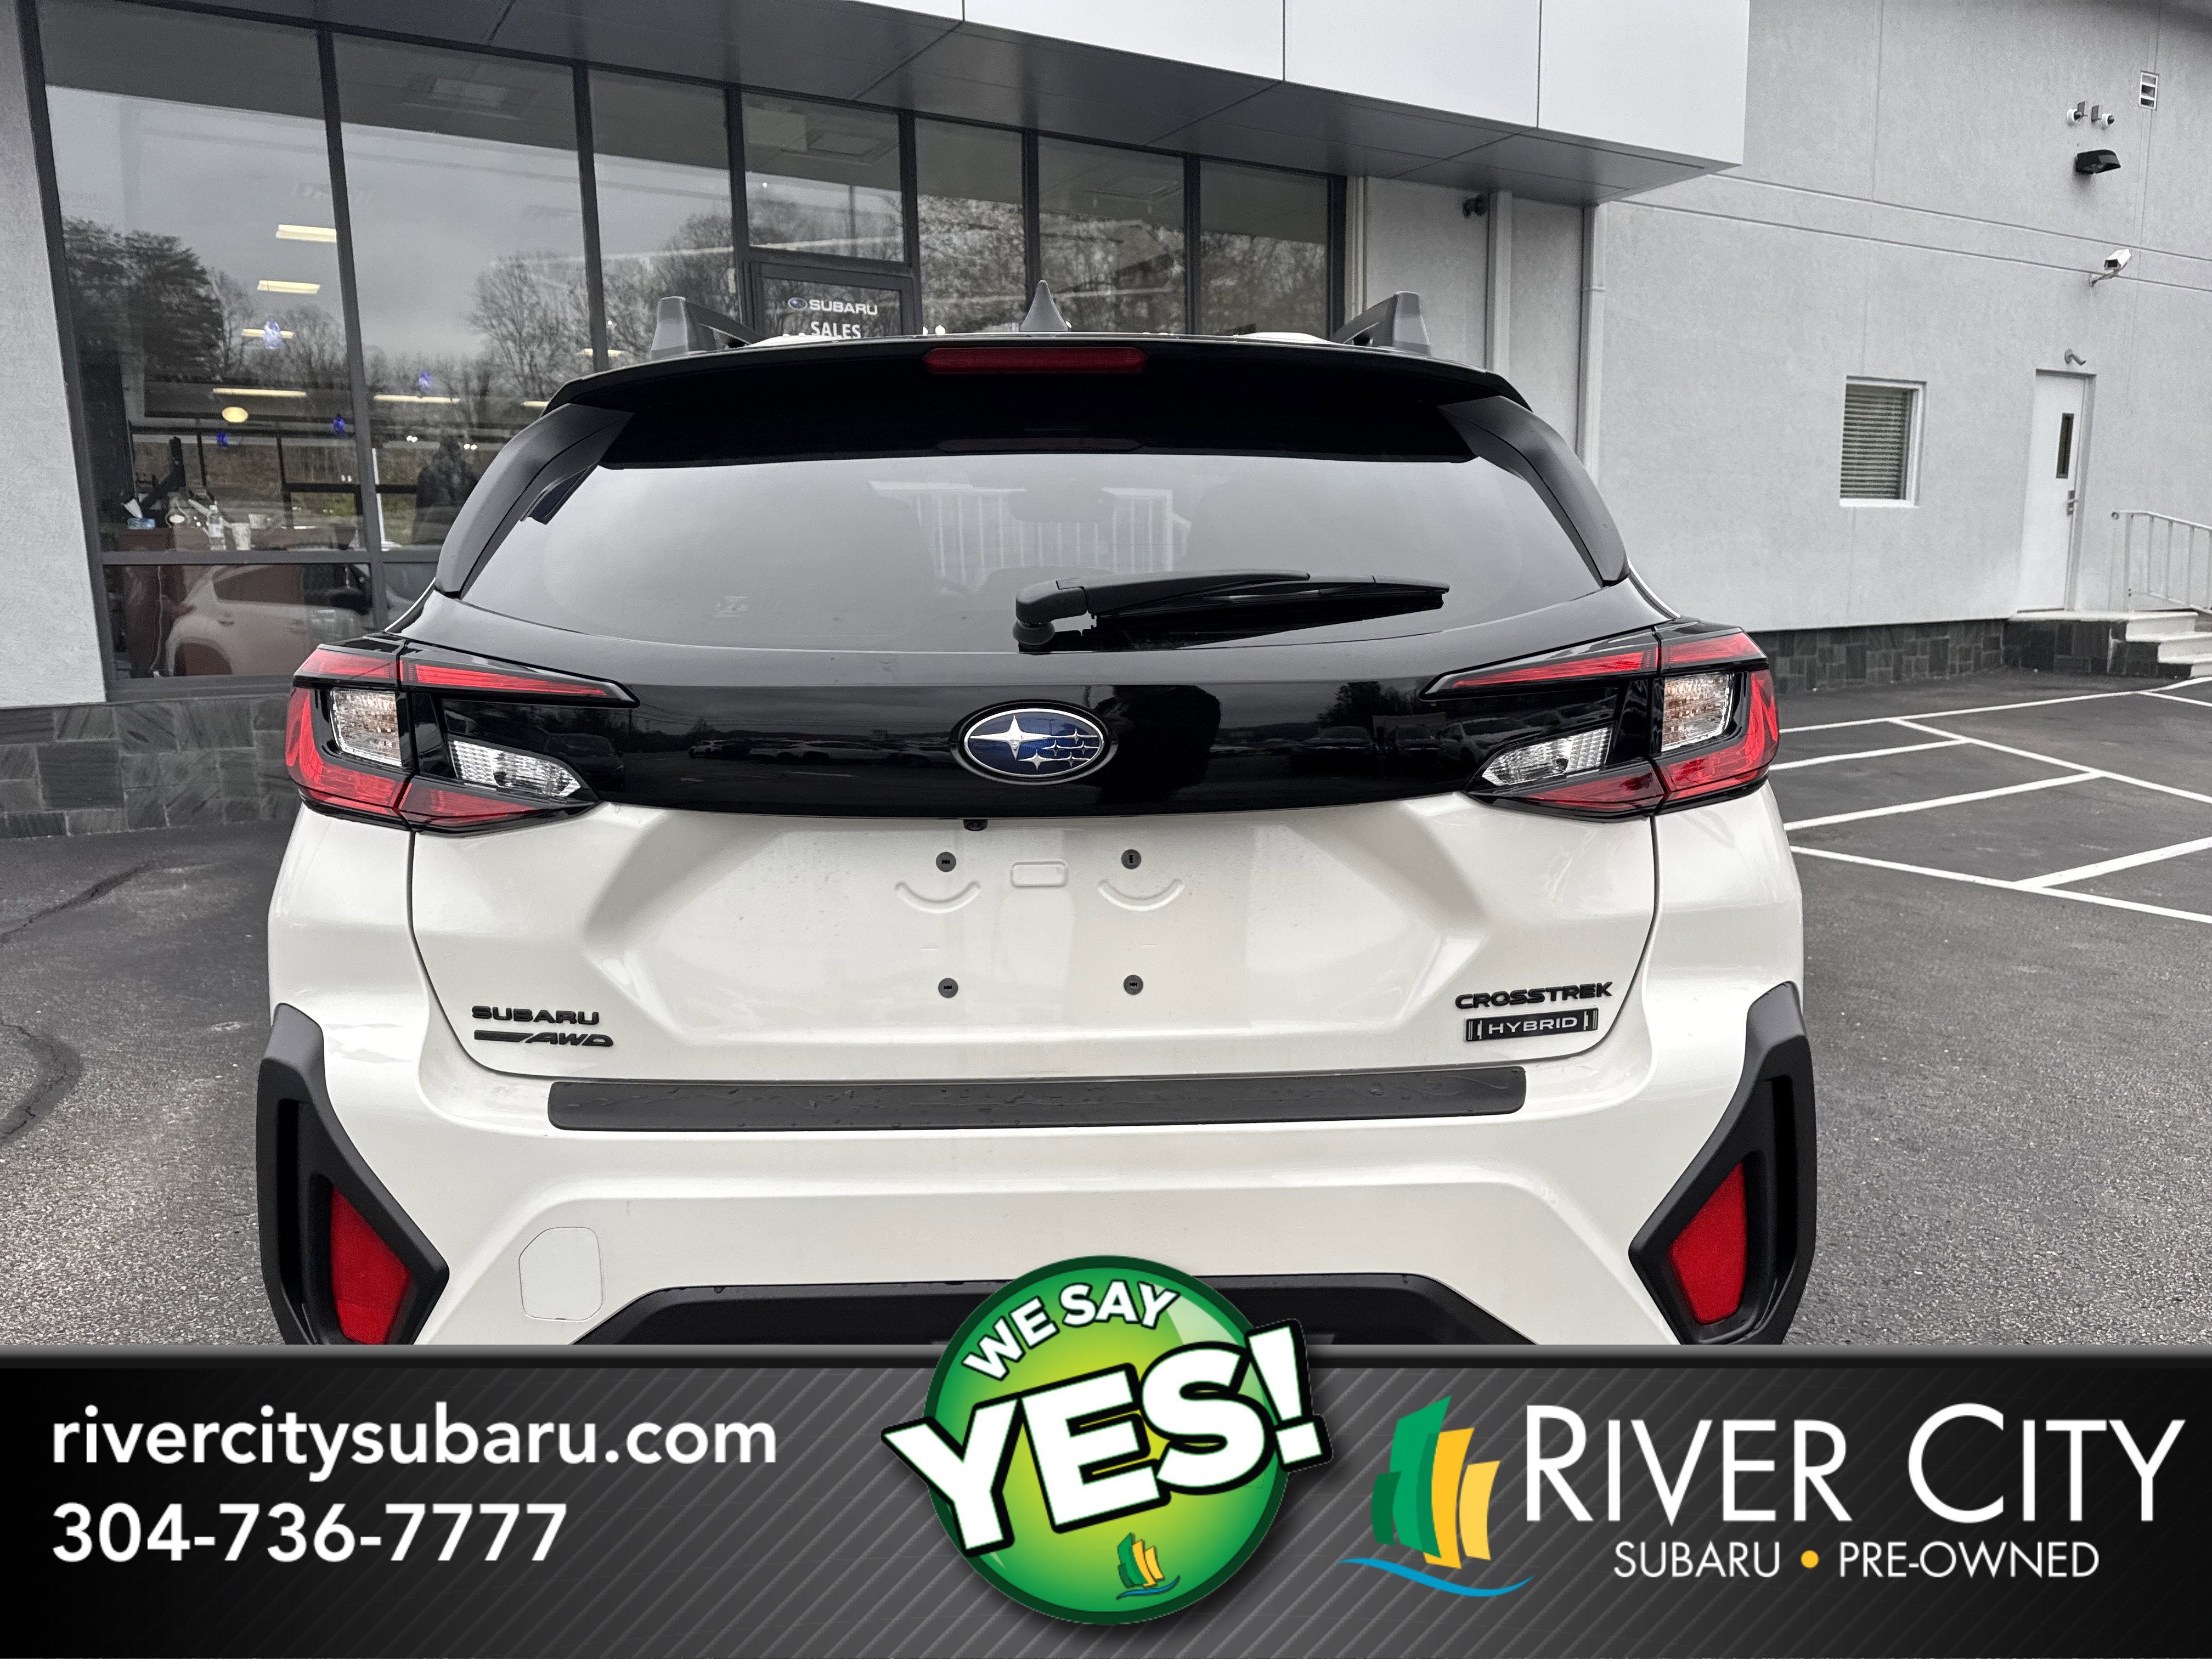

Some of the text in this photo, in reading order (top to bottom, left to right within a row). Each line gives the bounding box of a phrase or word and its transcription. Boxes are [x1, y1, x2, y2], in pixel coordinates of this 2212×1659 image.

[809, 299, 878, 316] SUBARU
[811, 321, 862, 339] SALES
[1455, 981, 1613, 1009] CROSSTREK
[471, 1005, 600, 1025] SUBARU
[1488, 1017, 1578, 1034] HYBRID
[524, 1032, 614, 1047] AWD
